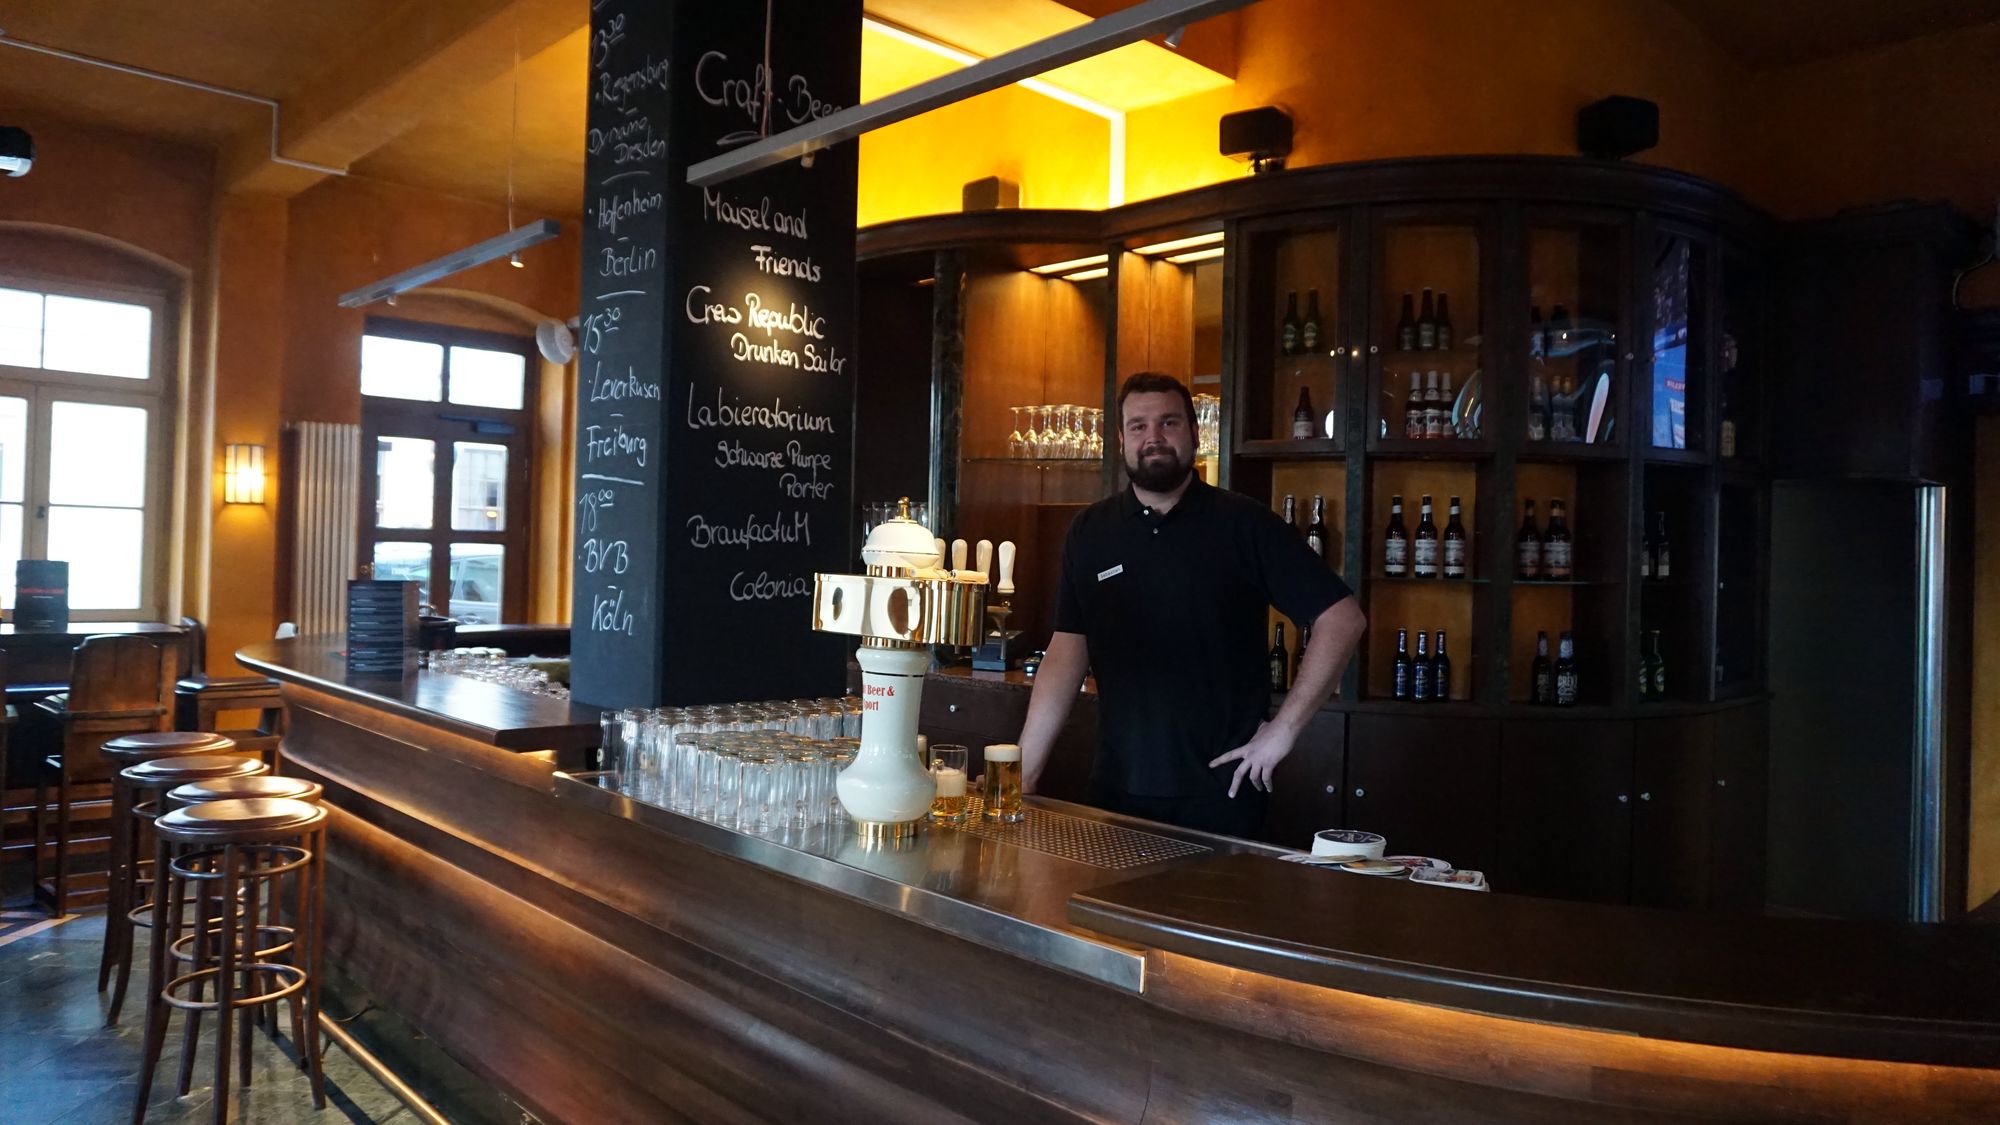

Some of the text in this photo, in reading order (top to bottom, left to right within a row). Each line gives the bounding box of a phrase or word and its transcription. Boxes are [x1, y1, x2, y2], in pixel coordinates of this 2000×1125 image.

[613, 124, 666, 164] Dresden
[703, 186, 808, 239] Maisel and
[600, 245, 656, 276] Berlin
[750, 245, 821, 282] Friends
[686, 285, 826, 339] Crew Republic
[730, 332, 847, 375] Drunken Sailor
[590, 360, 661, 402] Leverkusen
[687, 382, 835, 433] Labieratorium
[585, 424, 647, 468] Freiburg
[714, 439, 832, 482] Schwarze Pumpe
[779, 473, 835, 499] Porter
[583, 538, 629, 574] BVB
[730, 571, 811, 601] Colonia
[591, 590, 633, 636] Köln
[867, 684, 886, 697] Beer
[886, 686, 896, 697] &
